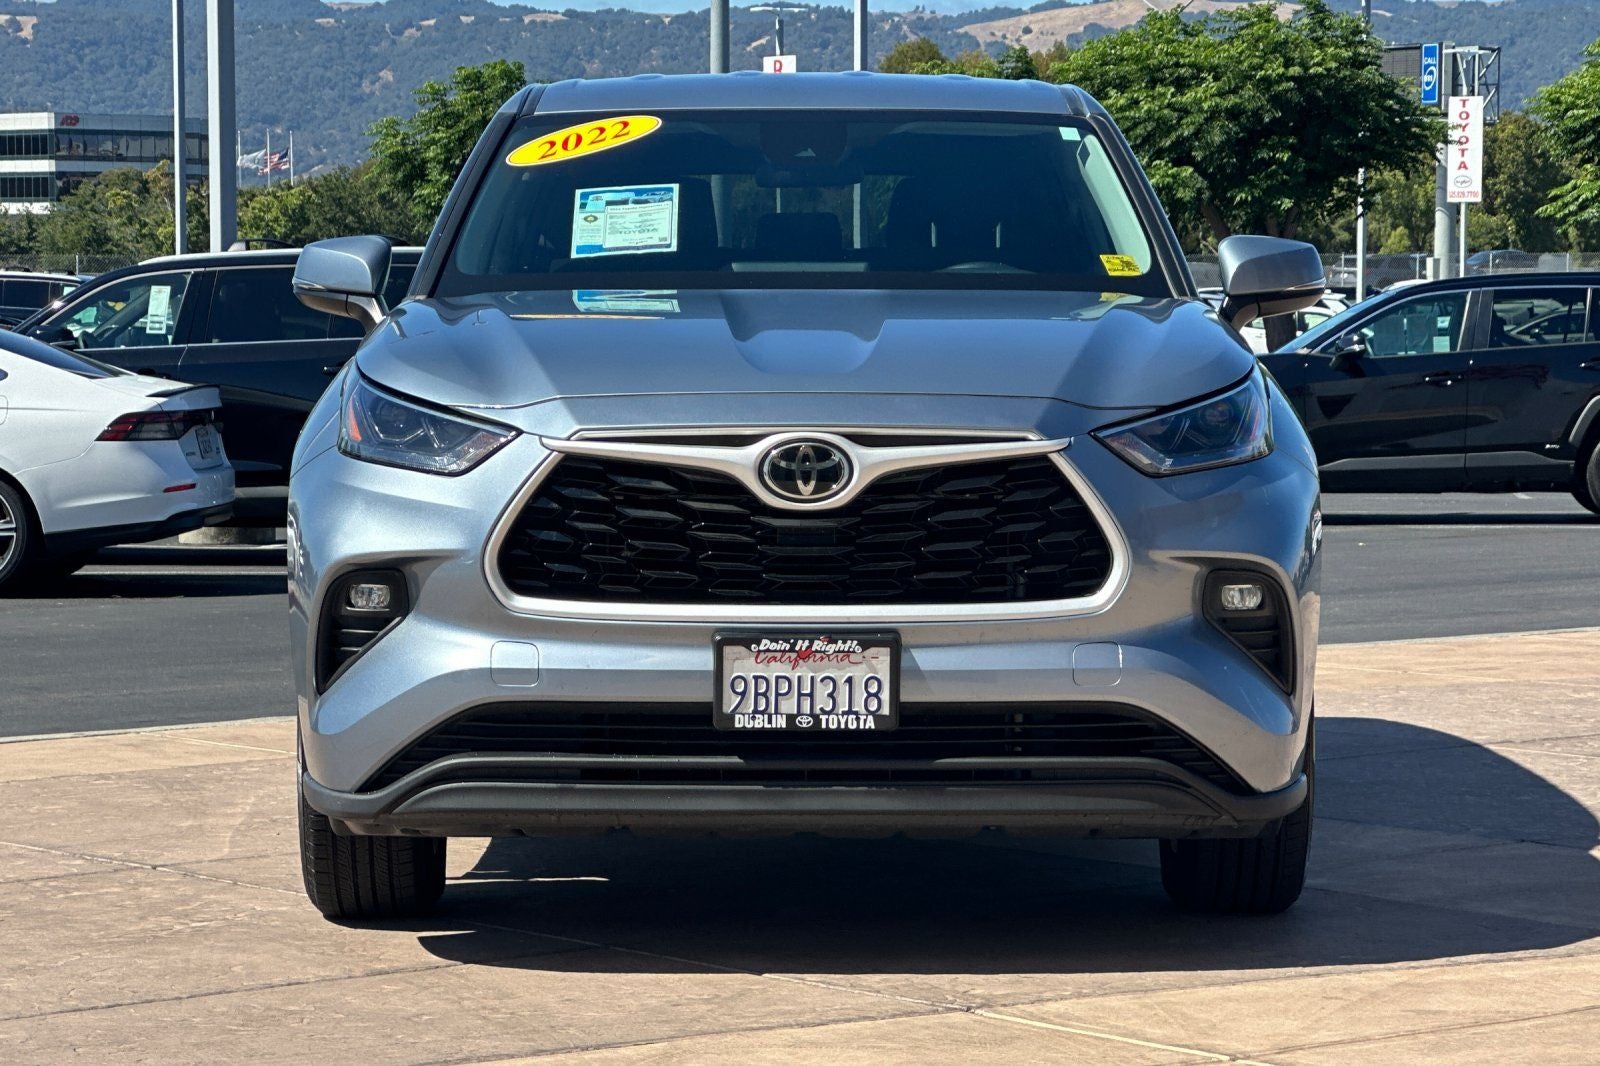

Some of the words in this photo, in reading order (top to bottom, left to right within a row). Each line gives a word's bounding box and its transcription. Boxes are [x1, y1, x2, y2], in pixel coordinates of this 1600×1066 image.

[538, 120, 631, 160] 2022
[1457, 99, 1470, 171] TOYOTA
[754, 651, 863, 670] California
[758, 639, 794, 651] Doin'
[795, 640, 810, 651] It
[811, 640, 857, 654] Right!
[729, 675, 882, 715] 9BPH318
[735, 714, 787, 728] DUBLIN
[820, 715, 875, 729] TOYOTA
